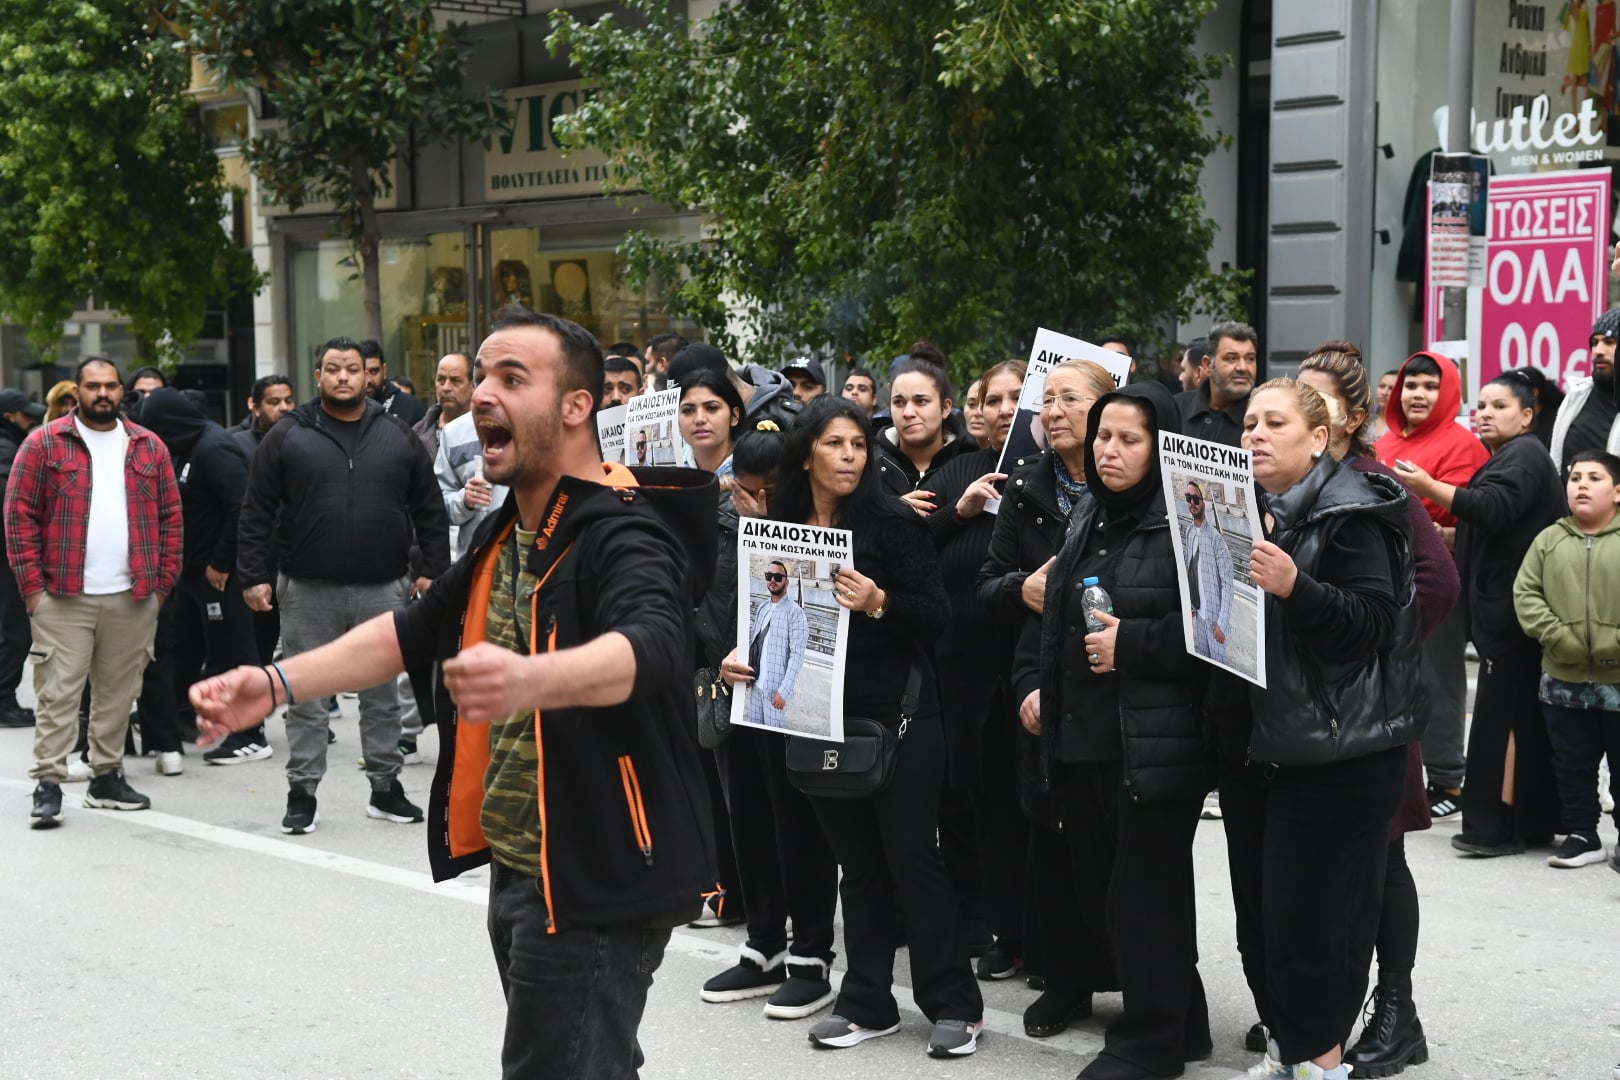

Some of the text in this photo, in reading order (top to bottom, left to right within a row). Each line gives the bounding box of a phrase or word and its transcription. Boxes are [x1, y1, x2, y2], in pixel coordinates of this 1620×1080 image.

[1510, 149, 1604, 167] MEN & WOMEN
[491, 168, 579, 190] ΠΟΛΥΤΕΛΕΙΑ
[1487, 196, 1593, 240] ΤΩΣΕΙΣ
[1489, 247, 1589, 306] ΟΛΑ
[1034, 364, 1048, 374] ΓΙΑ
[629, 392, 678, 412] ΔΙΚΑΙΟΣΥΝΗ
[1163, 436, 1249, 470] ΔΙΚΑΙΟΣΥΝΗ
[1163, 456, 1250, 484] ΓΙΑ ΤΟΝ ΚΩΣΤΑΚΗ ΜΟΥ
[543, 490, 569, 538] Admiral
[743, 521, 848, 547] ΔΙΚΑΙΟΣΥΝΗ
[743, 539, 848, 559] ΓΙΑ ΤΟΝ ΚΩΣΤΑΚΗ ΜΟΥ
